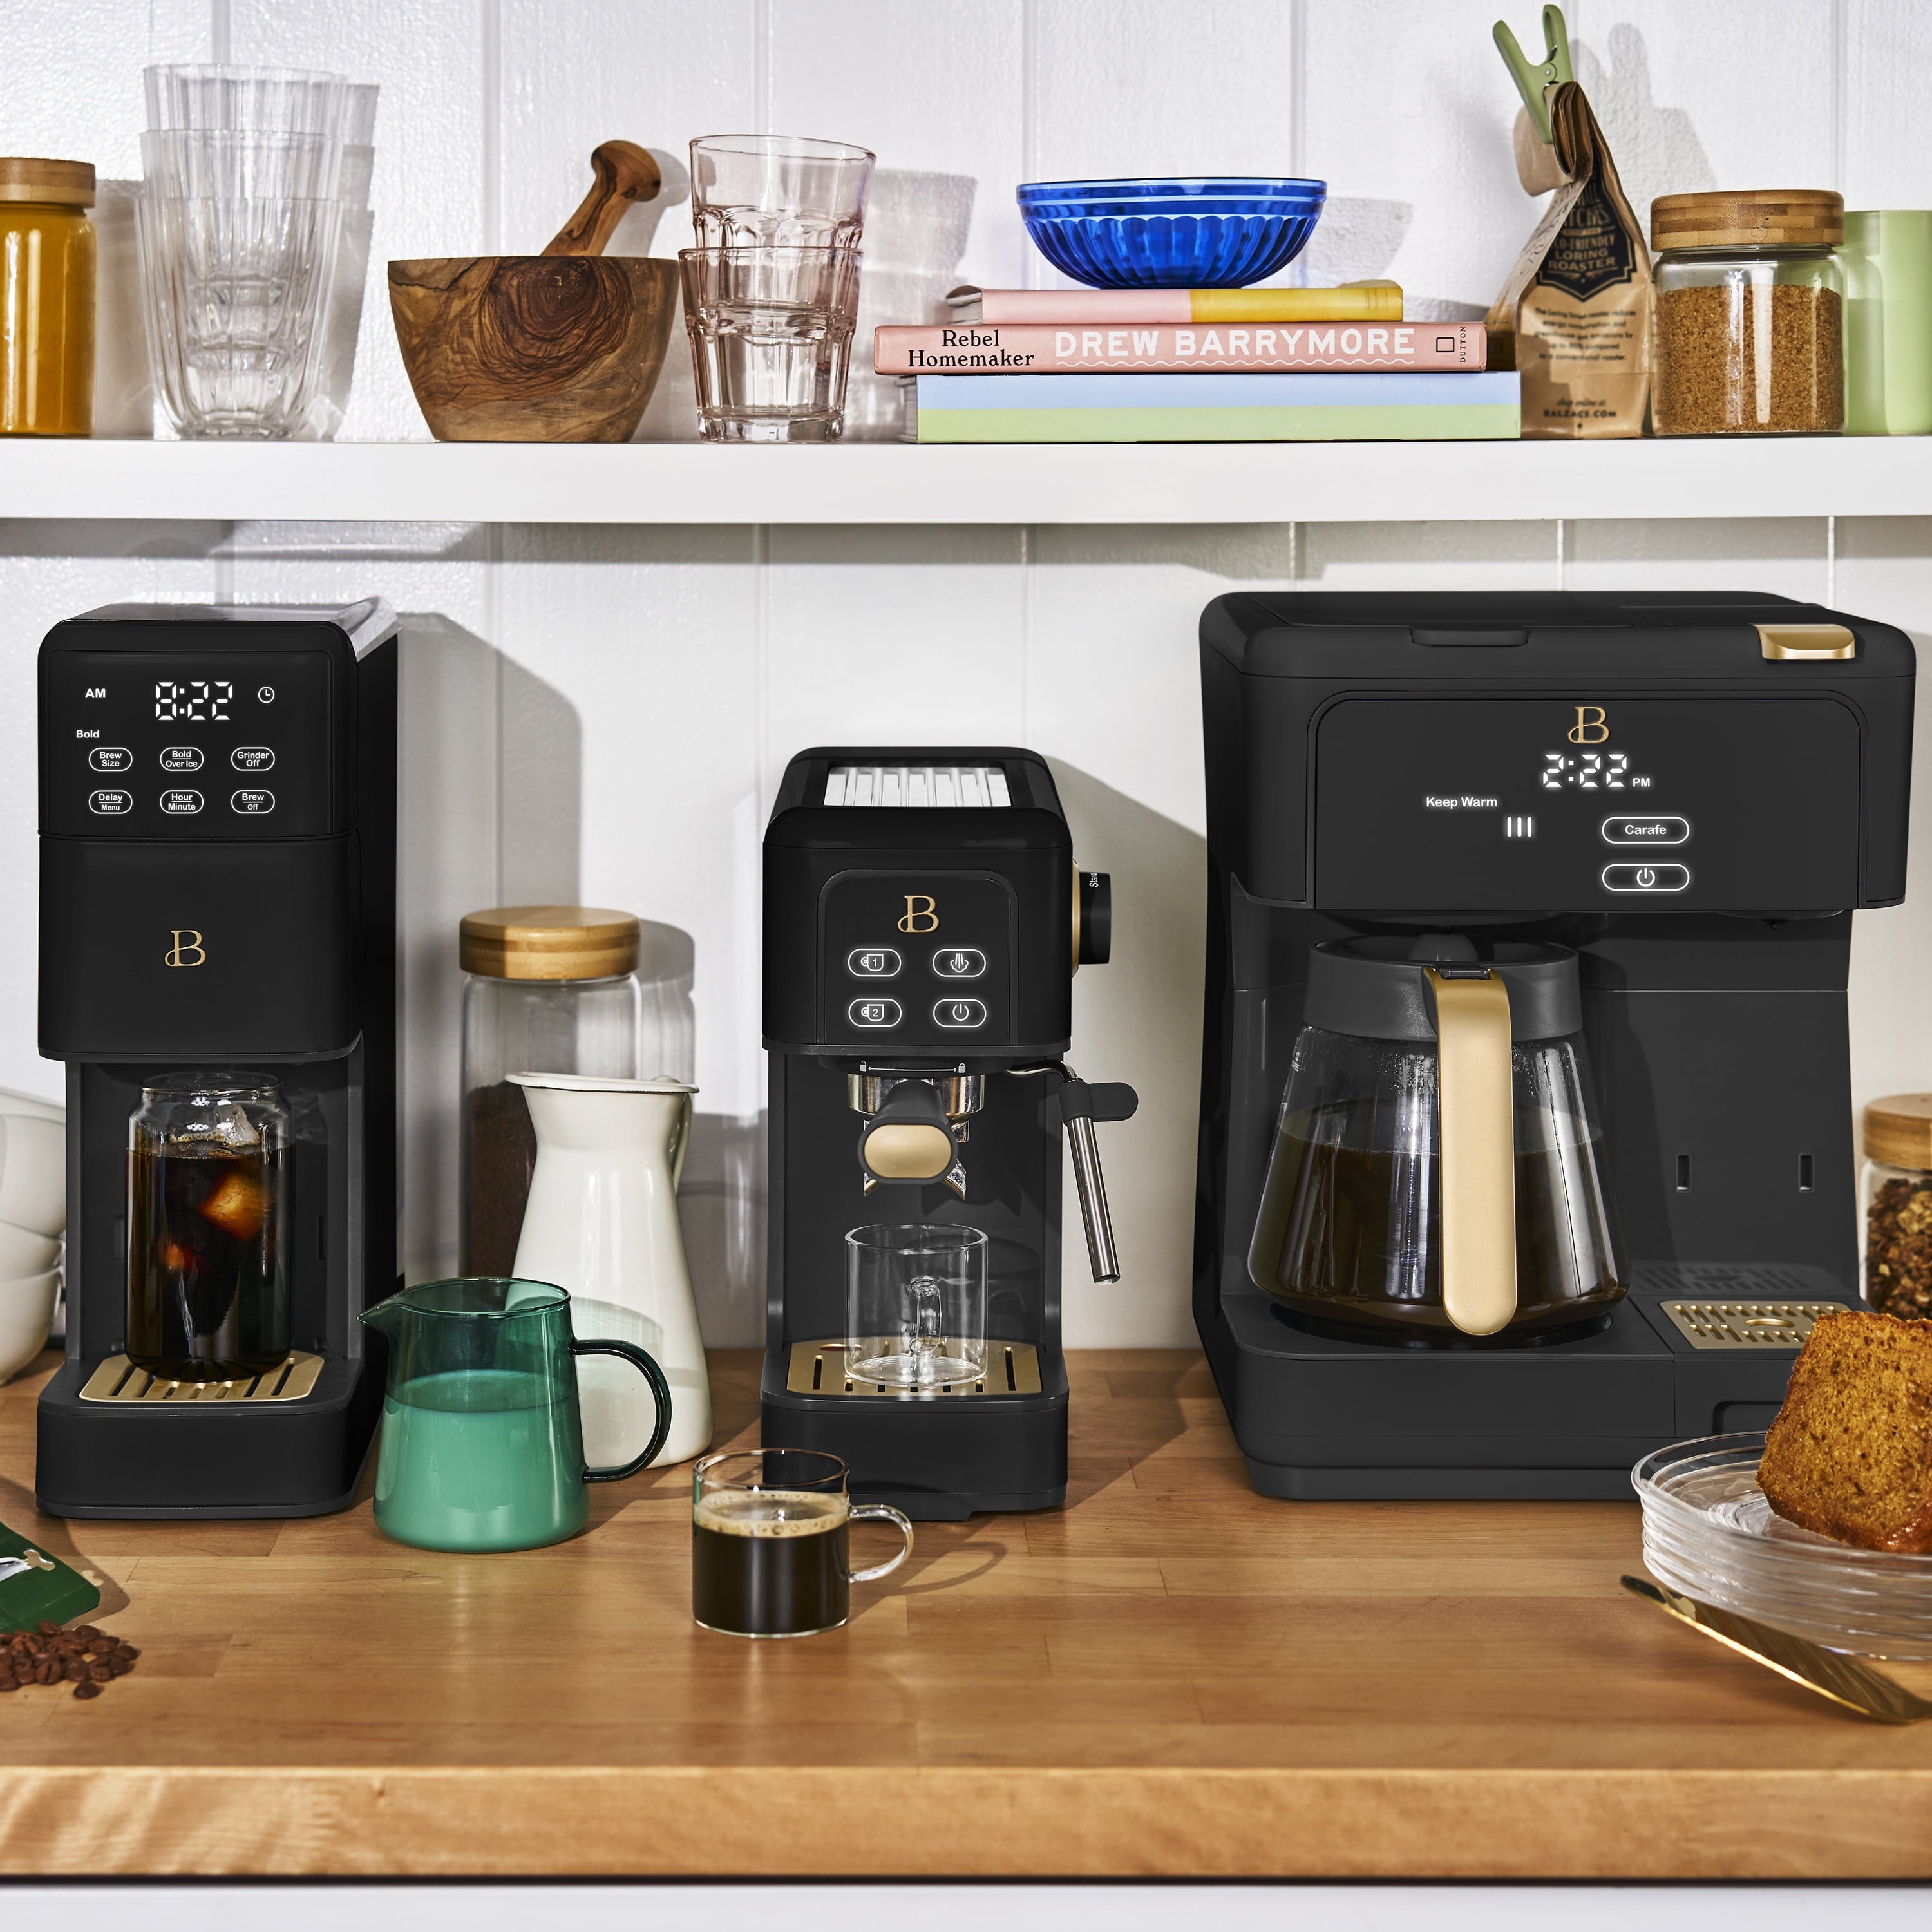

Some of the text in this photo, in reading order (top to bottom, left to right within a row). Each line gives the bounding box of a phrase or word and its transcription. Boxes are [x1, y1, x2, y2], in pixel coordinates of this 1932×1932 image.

[1551, 234, 1615, 250] CO-FRIENDLY
[1555, 248, 1608, 261] LORING
[1548, 256, 1615, 272] ROASTER
[942, 329, 999, 346] Rebel
[1625, 331, 1633, 339] by
[1056, 328, 1414, 357] DREW BARRYMORE
[908, 348, 1034, 367] Homemaker
[85, 688, 106, 699] AM
[155, 681, 233, 720] 8:22
[1567, 706, 1610, 743] B
[76, 730, 100, 739] Bold
[172, 750, 191, 759] Bold
[1543, 754, 1627, 788] 2:22
[1633, 777, 1651, 787] PM
[99, 793, 123, 803] Delay
[1426, 797, 1497, 809] Keep Warm
[167, 802, 196, 811] Minute
[1625, 825, 1667, 835] Carafe
[897, 896, 940, 933] B
[164, 929, 206, 967] B
[872, 958, 877, 967] 1
[873, 1008, 879, 1017] 2
